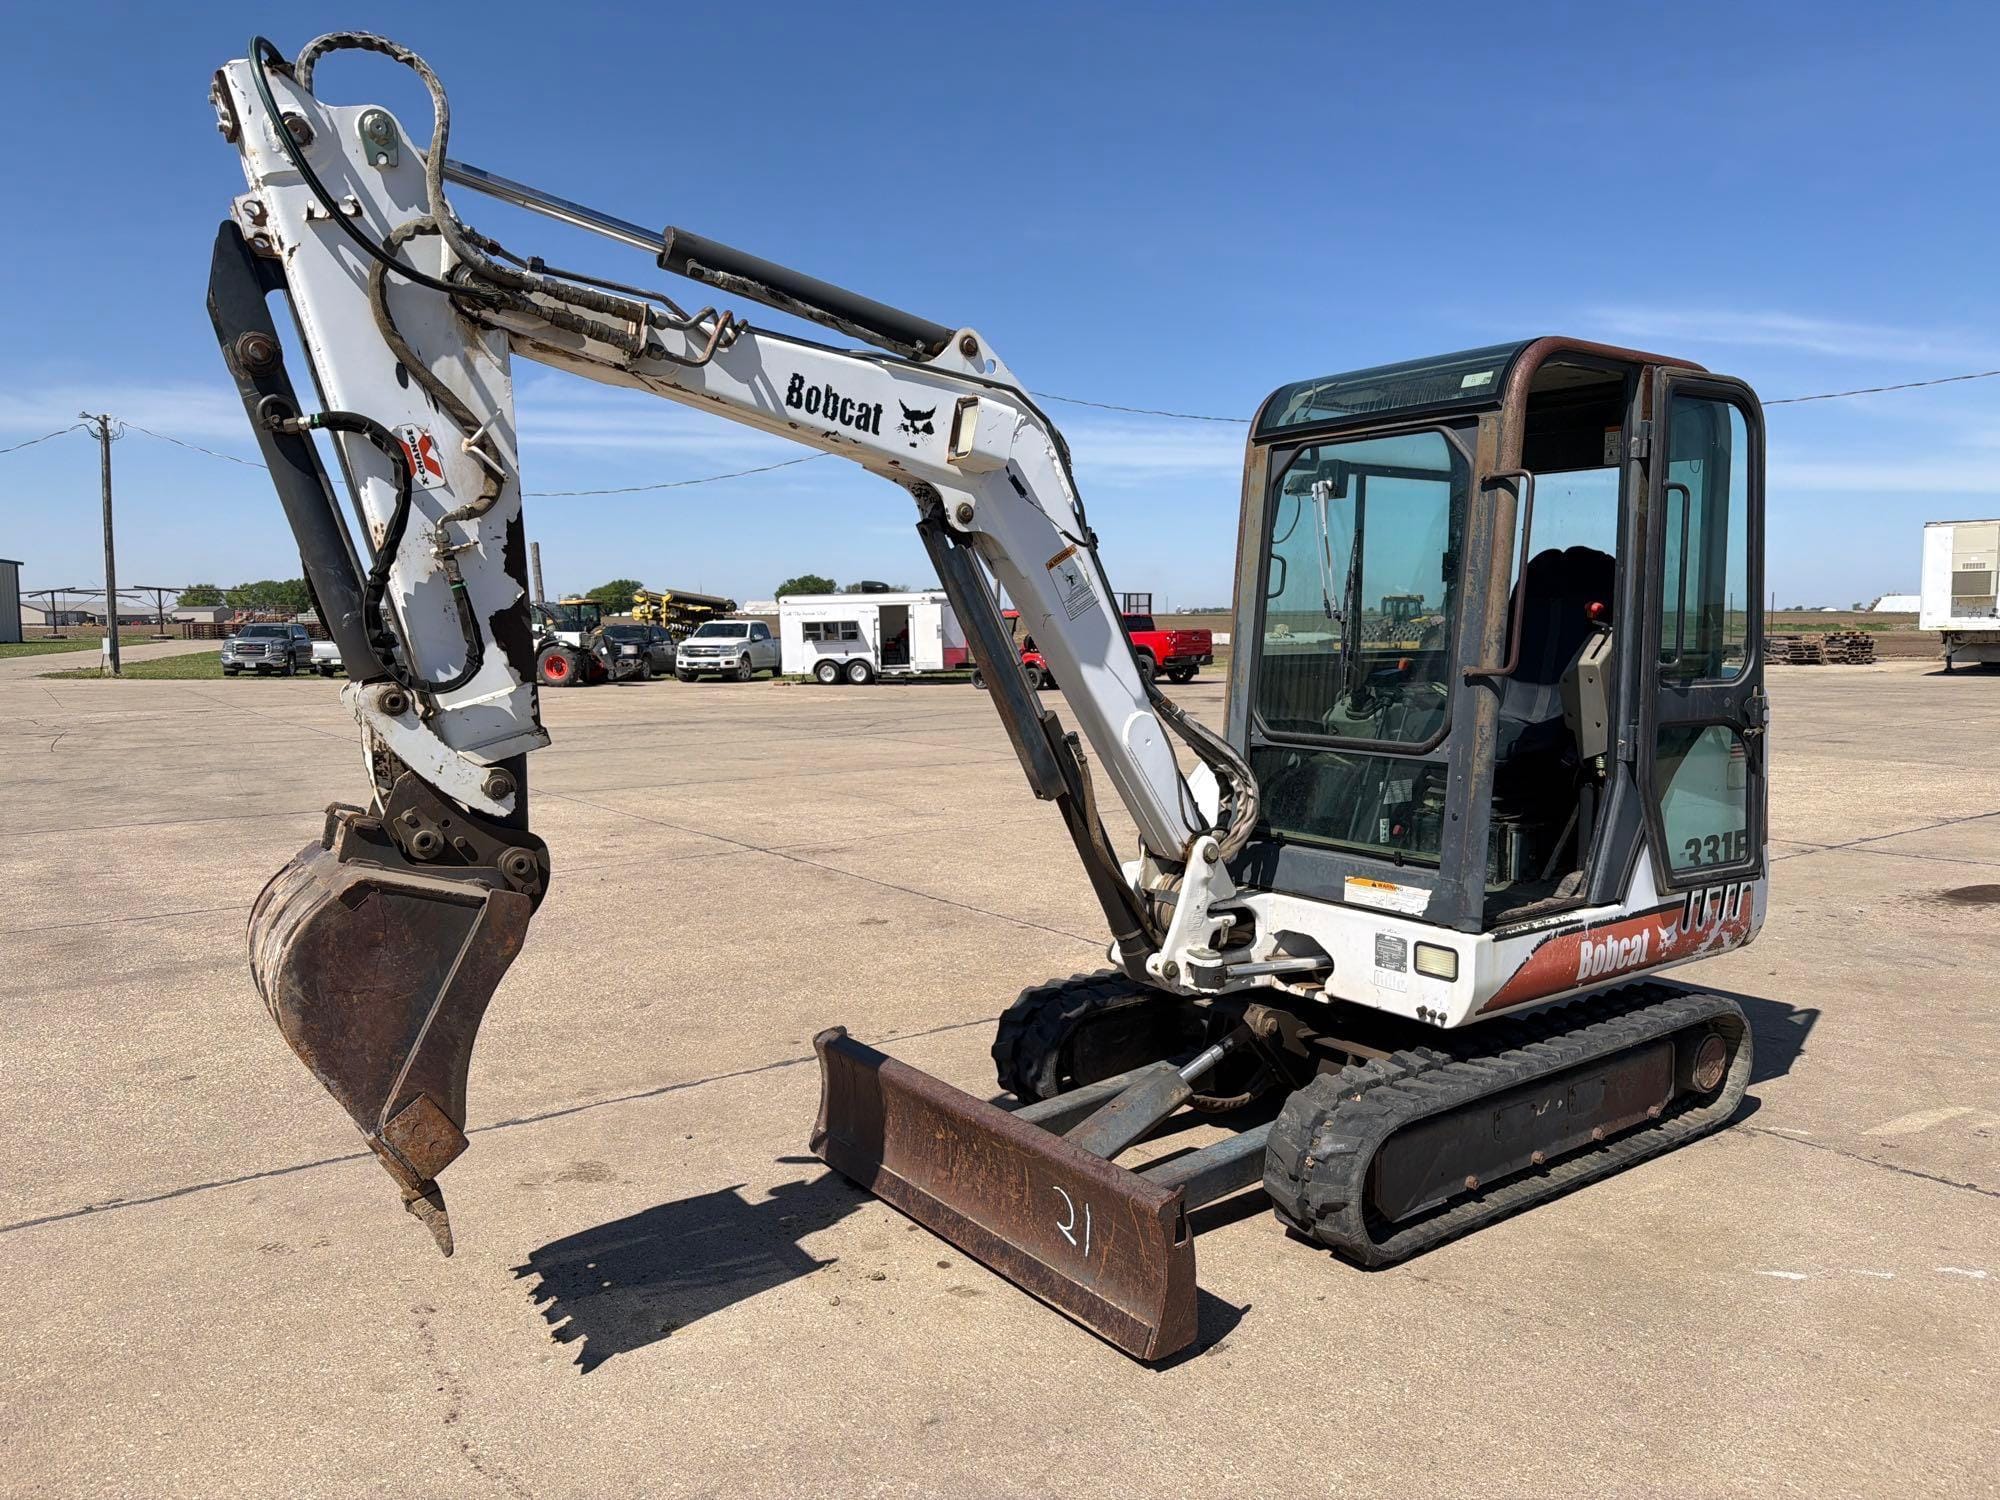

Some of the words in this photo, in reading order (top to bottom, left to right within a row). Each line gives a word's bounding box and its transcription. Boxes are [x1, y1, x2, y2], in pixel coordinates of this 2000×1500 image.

[785, 372, 883, 436] Bobcat
[406, 428, 429, 485] X-CHANGE
[1576, 928, 1650, 981] Bobcat
[1052, 1186, 1091, 1257] 21
